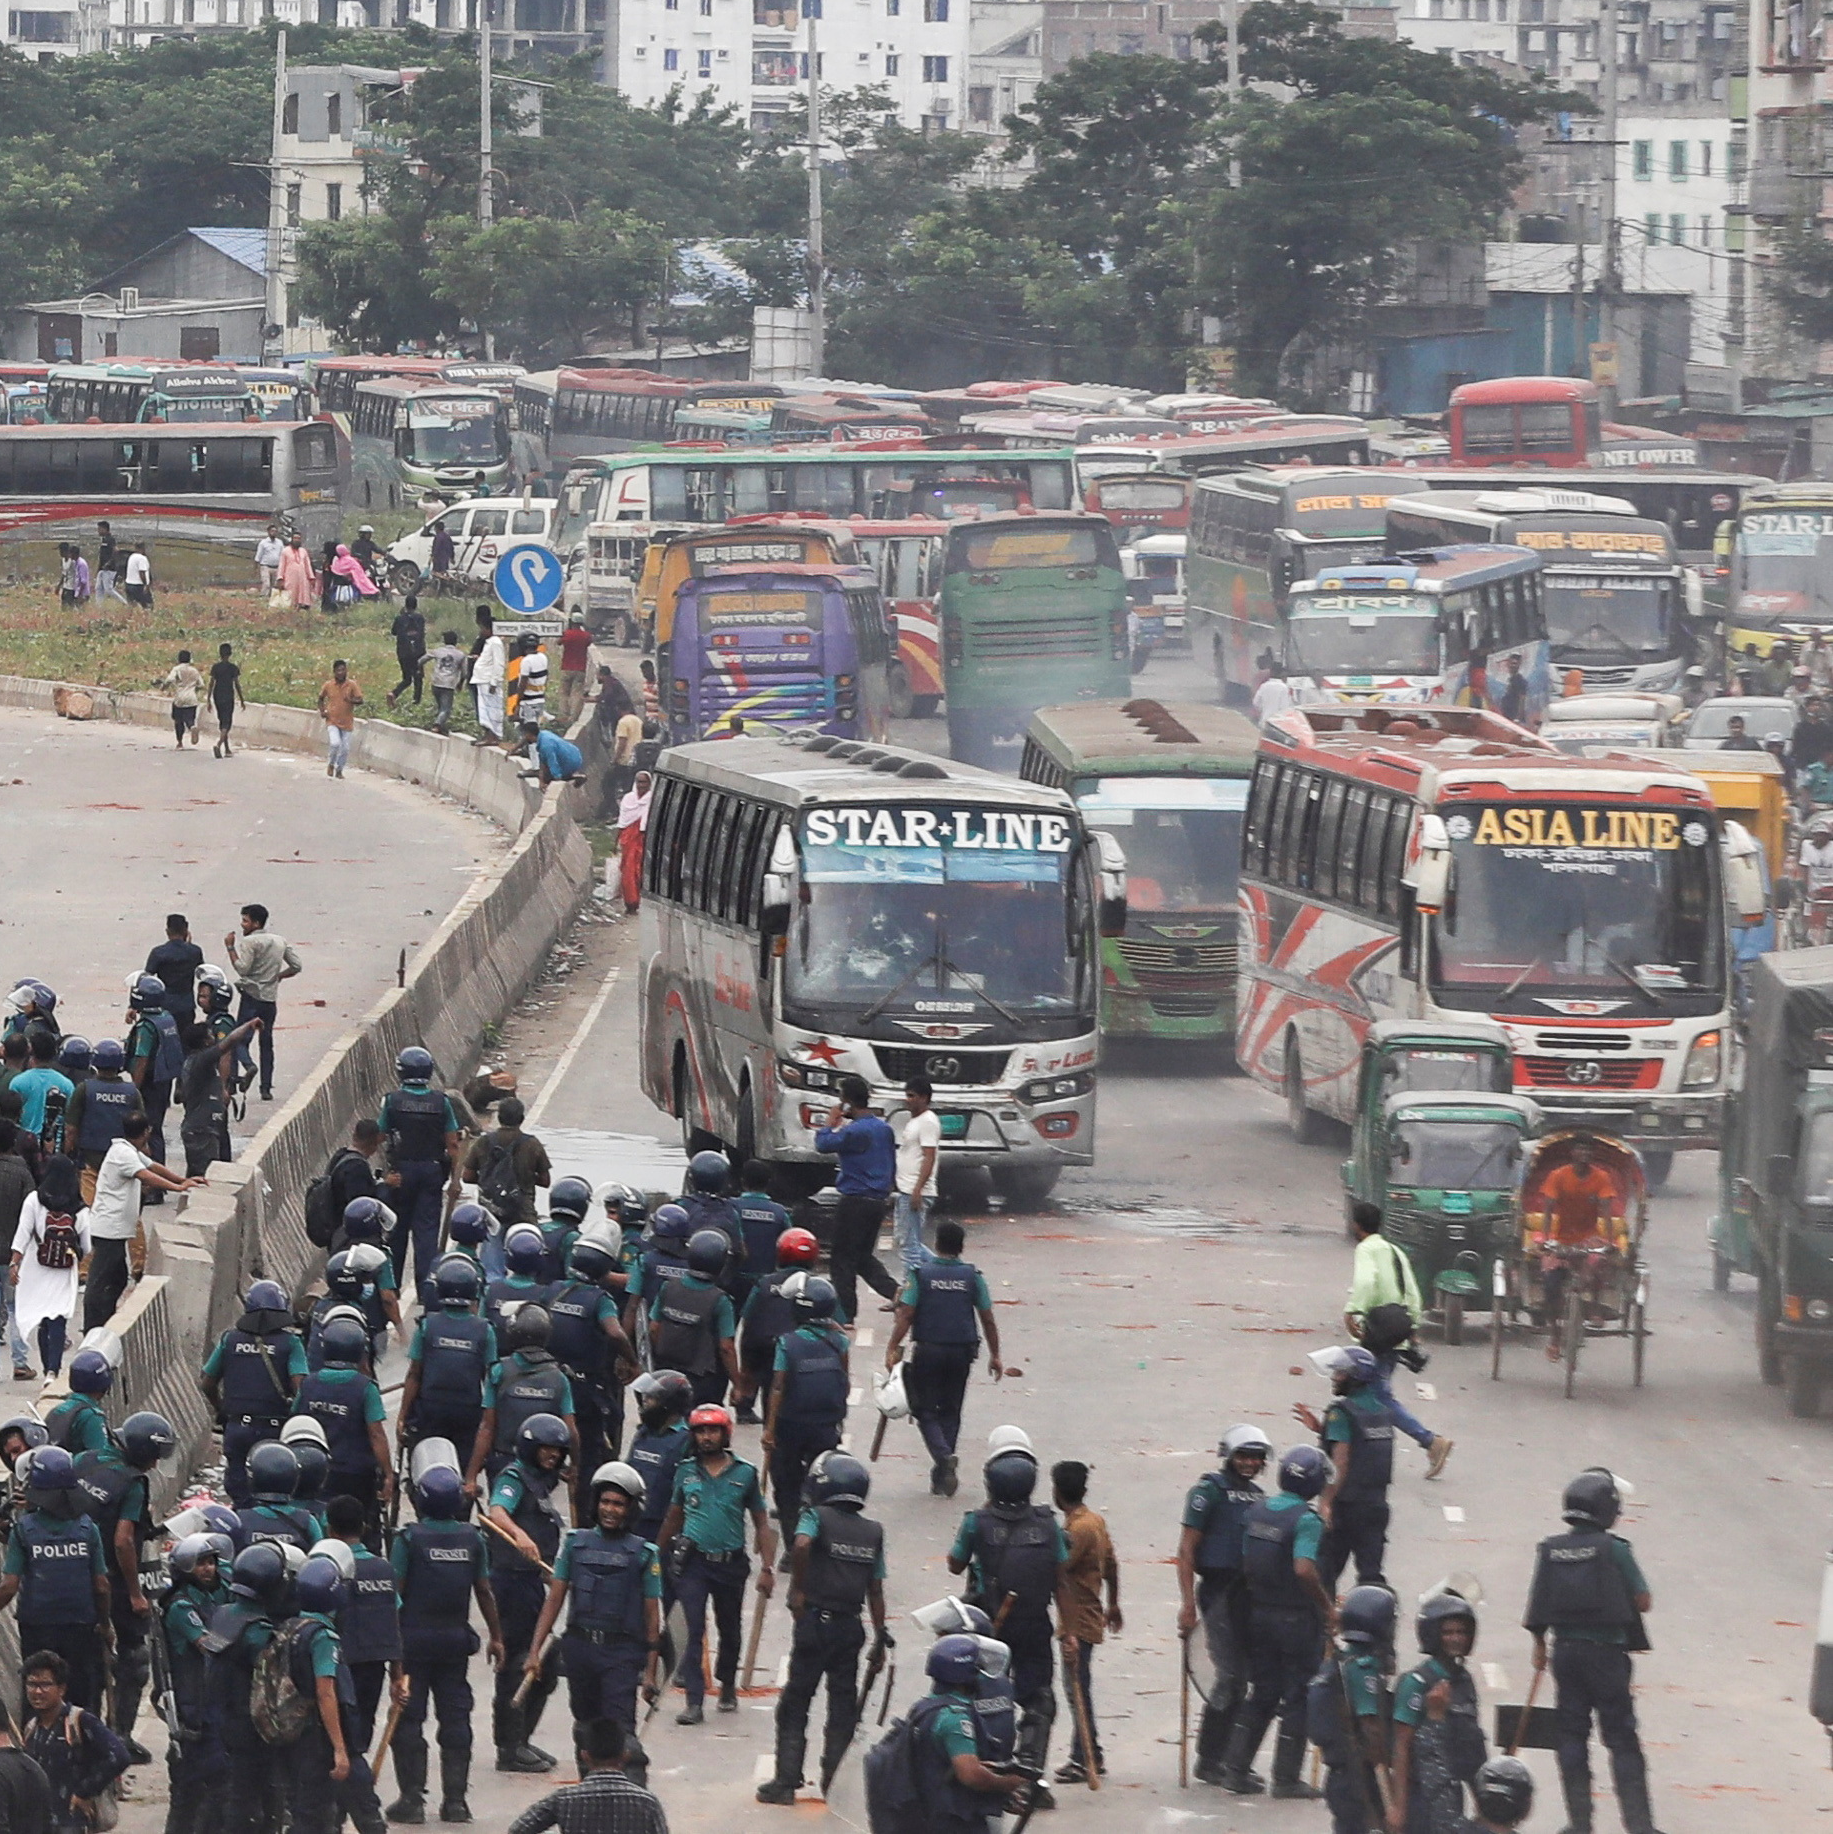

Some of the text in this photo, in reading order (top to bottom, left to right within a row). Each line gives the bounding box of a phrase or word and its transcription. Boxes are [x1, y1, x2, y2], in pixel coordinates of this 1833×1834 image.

[166, 375, 238, 387] Allahu Akbar
[1599, 448, 1697, 467] NFLOWER
[1742, 514, 1817, 536] STAR
[806, 809, 1073, 853] STAR LINE
[1473, 808, 1682, 850] ASIA LINE
[96, 1092, 127, 1104] POLICE
[930, 1279, 968, 1292] POLICE
[308, 1401, 349, 1416] POLICE
[31, 1542, 90, 1559] POLICE
[337, 1579, 374, 1593] POLICE
